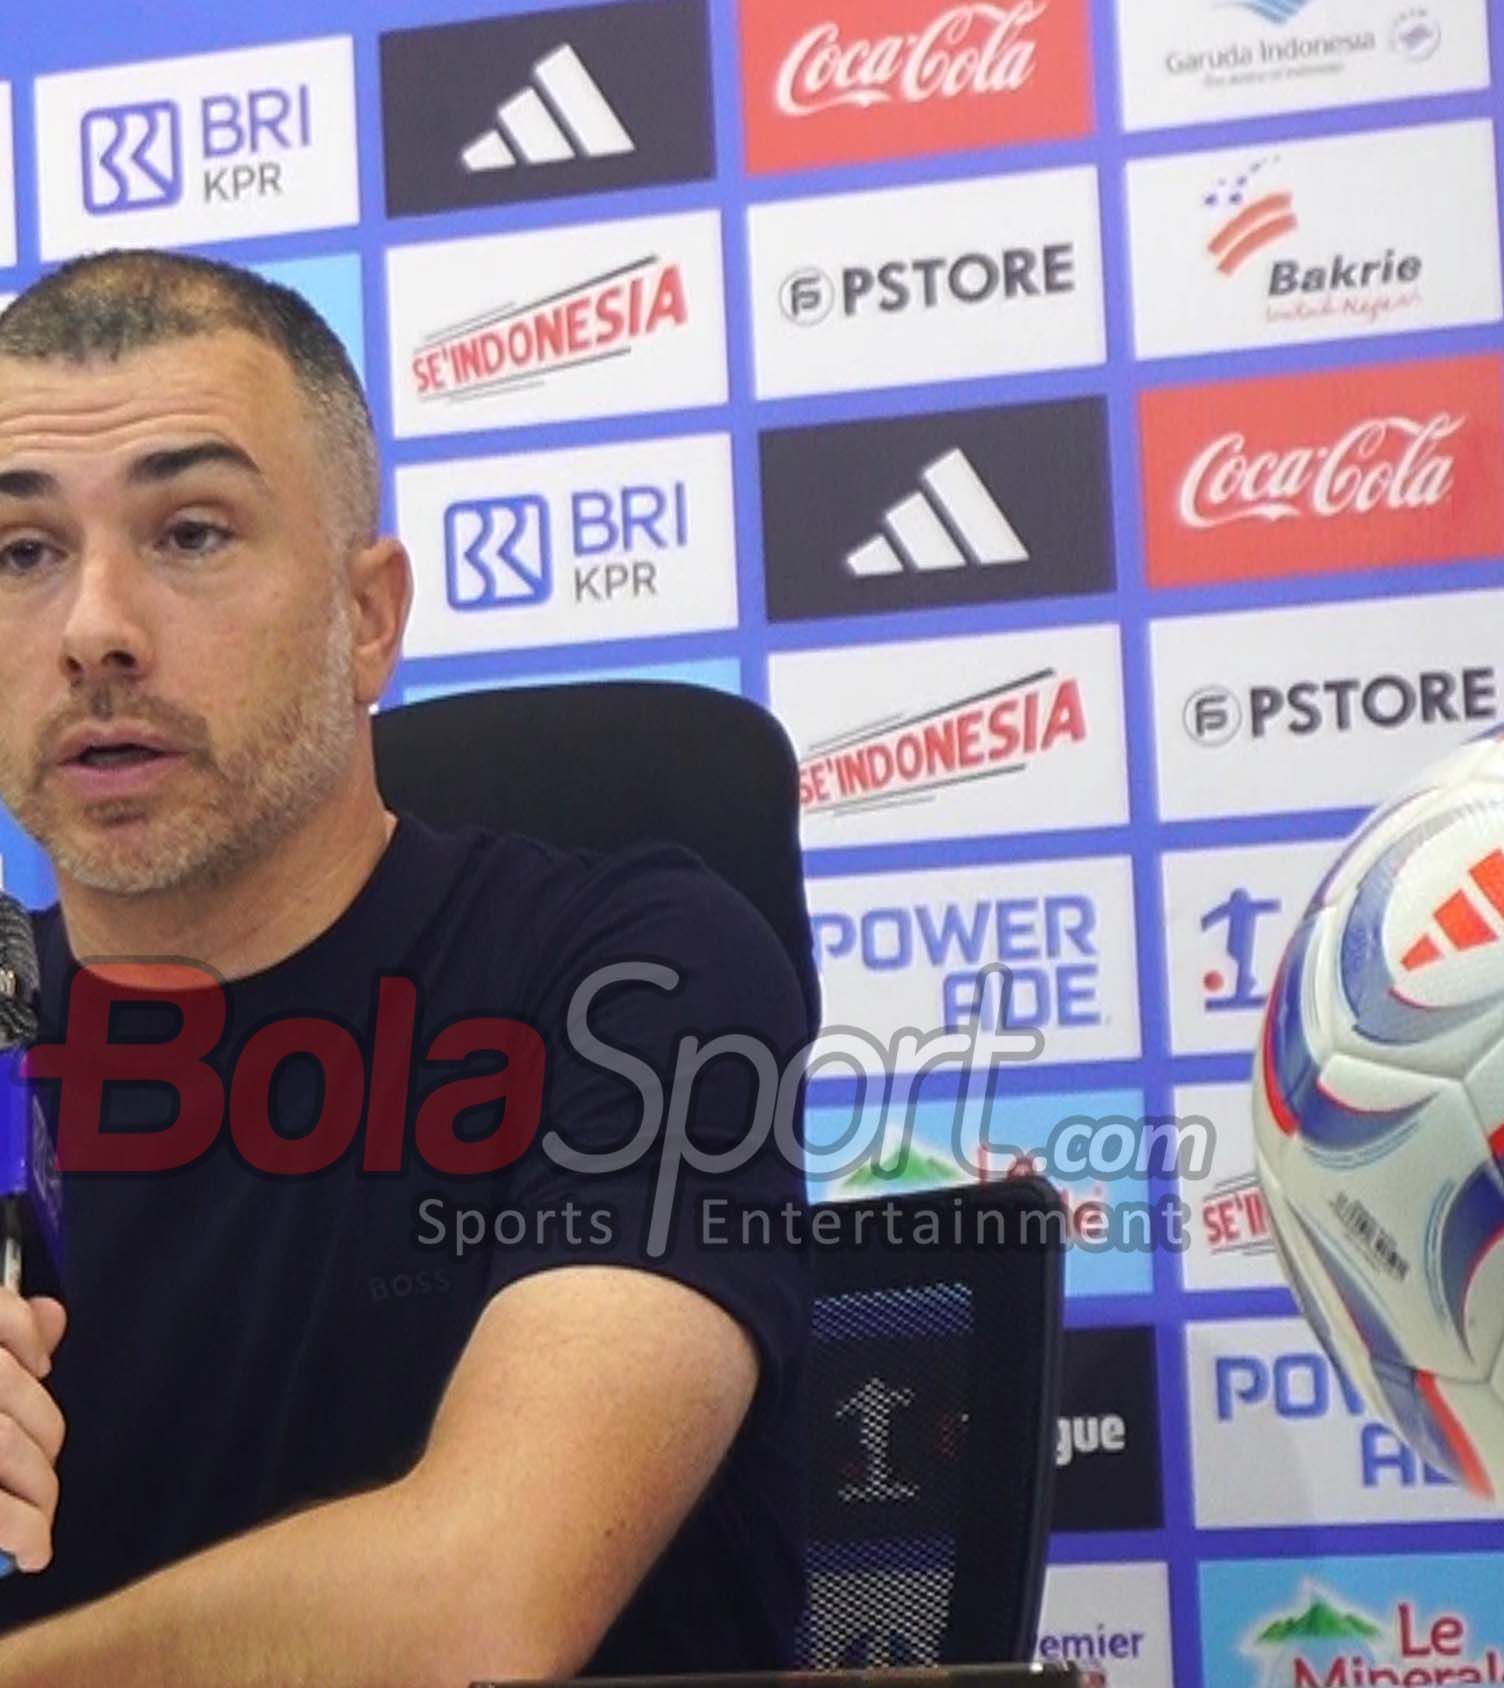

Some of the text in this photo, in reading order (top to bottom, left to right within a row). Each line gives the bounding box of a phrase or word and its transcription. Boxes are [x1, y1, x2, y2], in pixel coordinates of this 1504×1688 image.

[1165, 44, 1253, 76] Garuda
[1260, 30, 1376, 63] Indonesia
[201, 83, 311, 159] BRI
[203, 162, 284, 204] KPR
[842, 241, 1076, 318] PSTORE
[1268, 248, 1423, 297] Bakrie
[411, 262, 688, 394] SE'INDONESIA
[571, 480, 687, 558] BRI
[574, 561, 658, 603] KPR
[1250, 666, 1497, 739] PSTORE
[809, 894, 1098, 973] POWER
[1056, 1413, 1126, 1467] gue
[1039, 1622, 1145, 1661] emier
[1398, 1602, 1464, 1658] Le
[1294, 1651, 1504, 1688] Mineral
